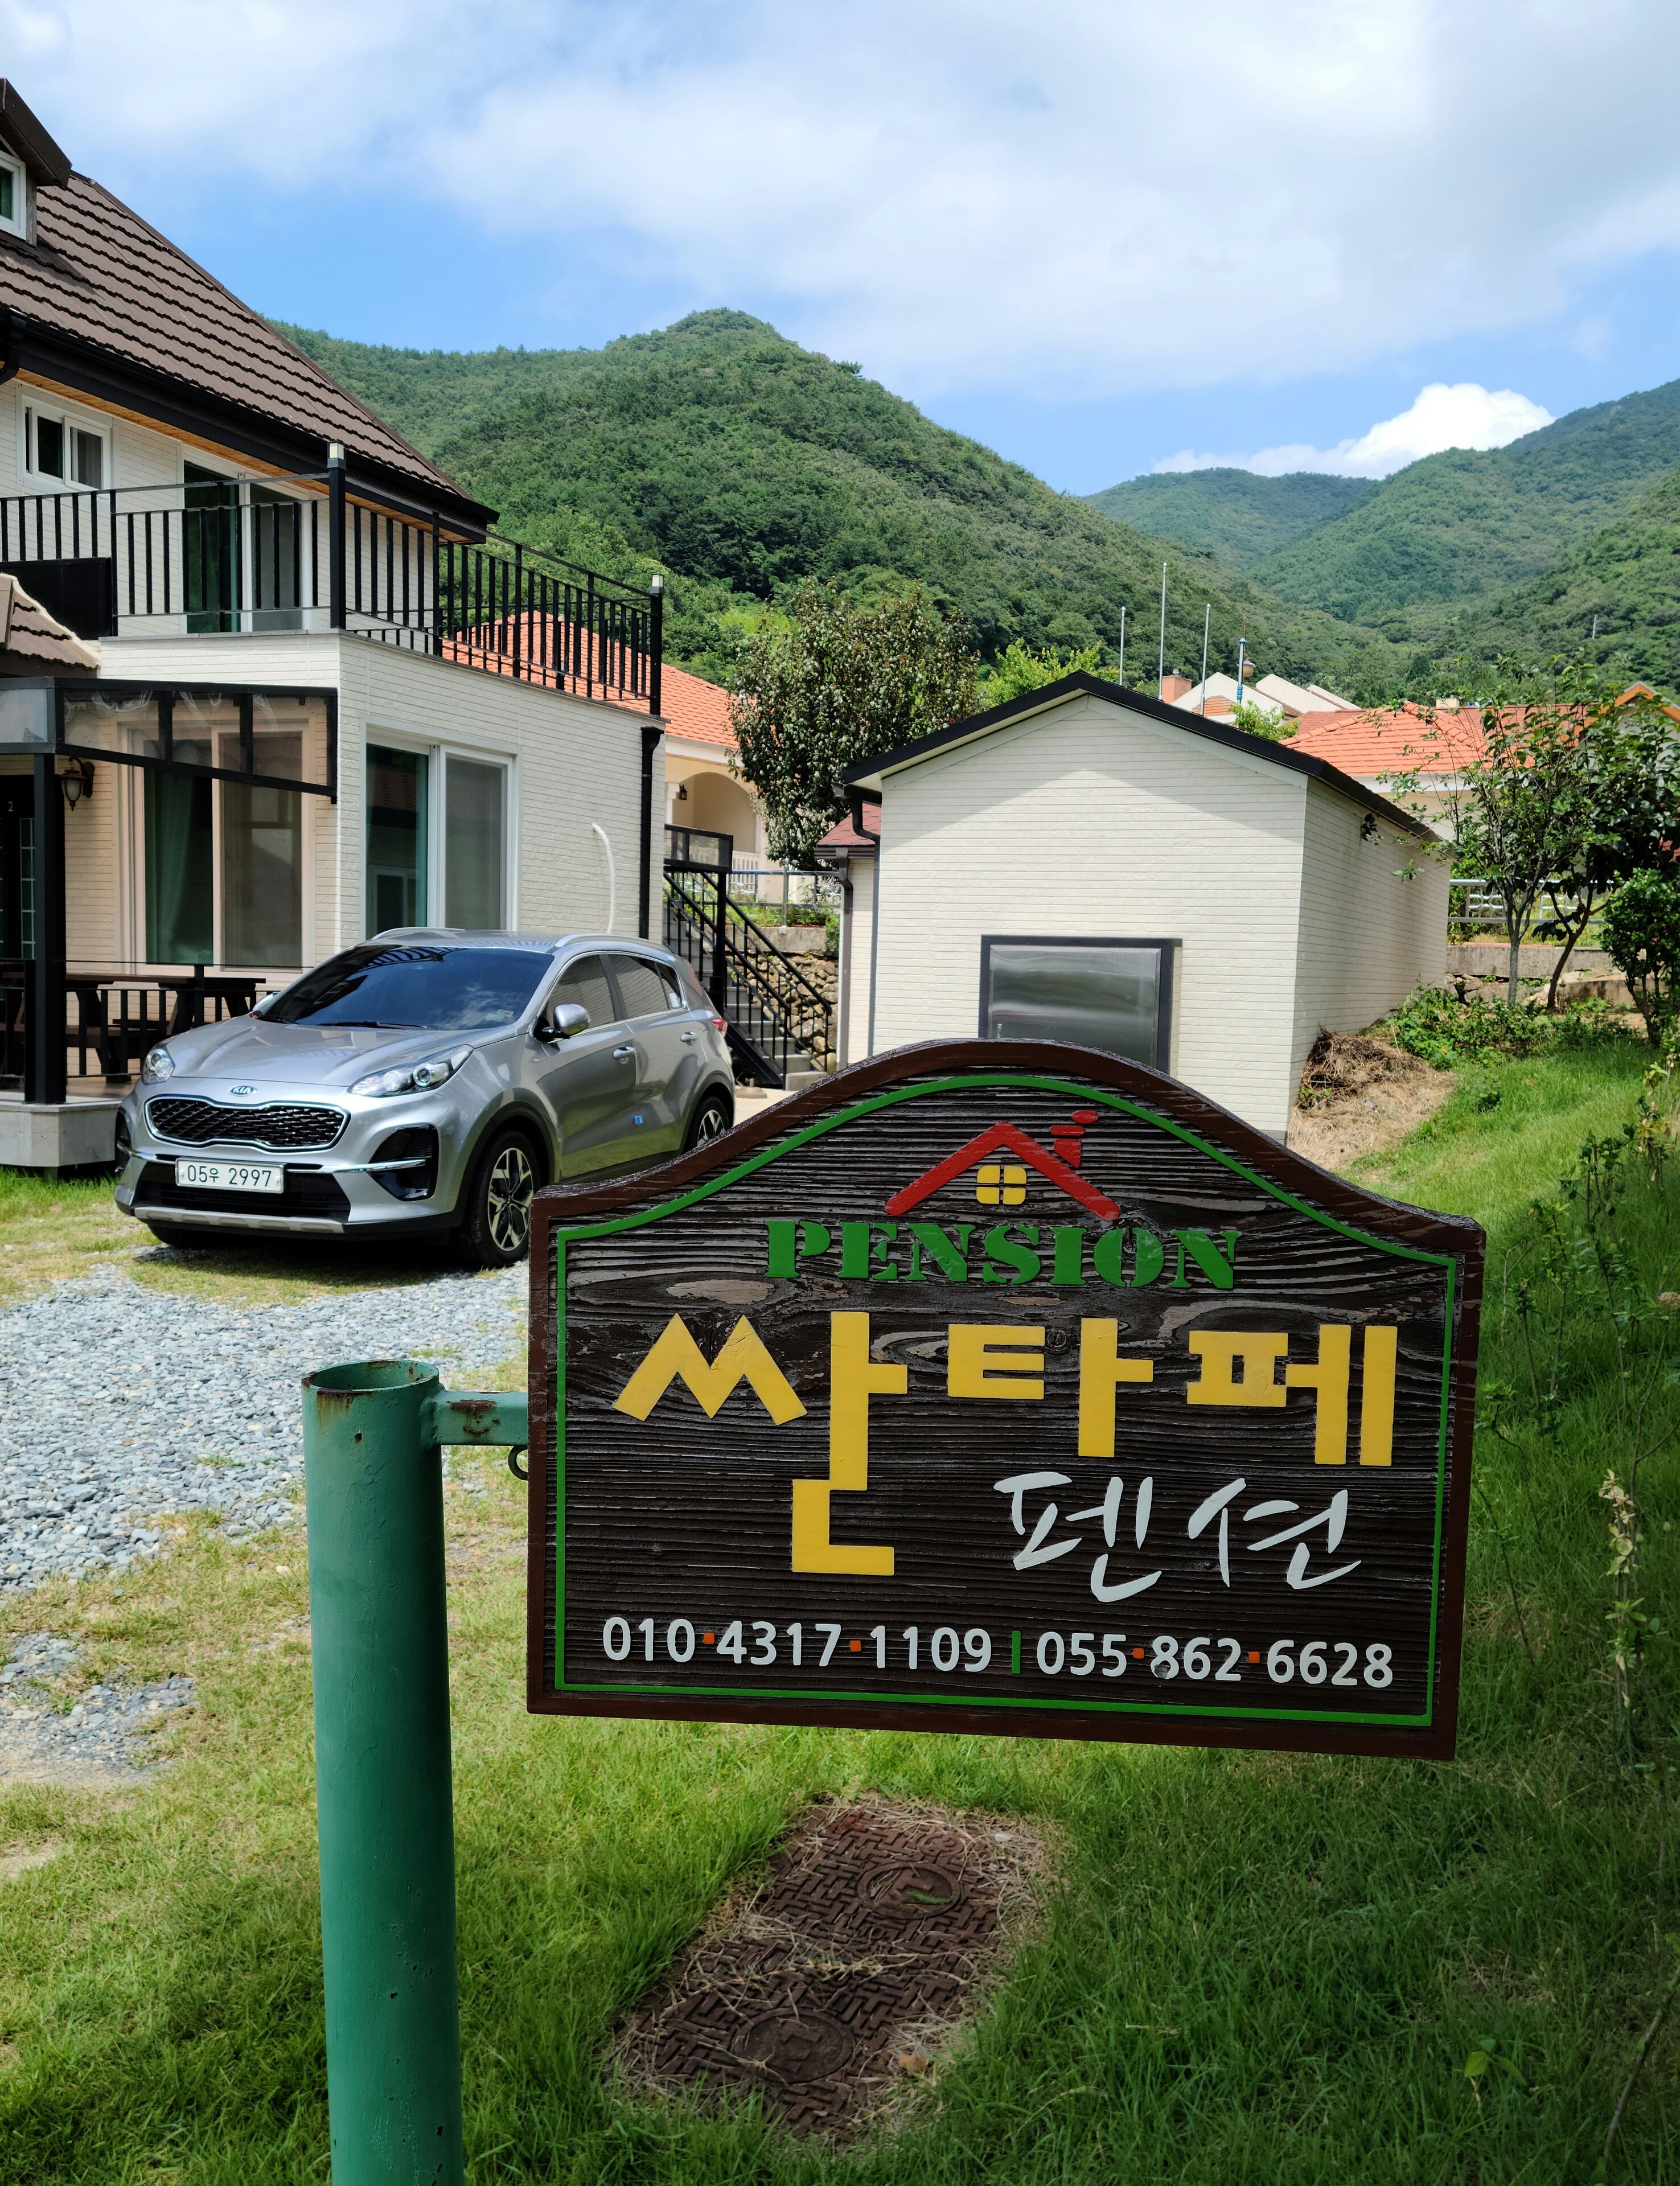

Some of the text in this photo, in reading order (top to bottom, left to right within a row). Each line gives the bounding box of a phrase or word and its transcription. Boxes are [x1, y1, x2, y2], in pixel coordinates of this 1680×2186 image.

[8, 801, 14, 812] 2
[232, 1086, 251, 1094] KIA
[187, 1165, 272, 1187] 05우 2997
[763, 1219, 1242, 1290] PENSION
[613, 1310, 1397, 1576] 싼타페
[993, 1470, 1362, 1604] 펜션
